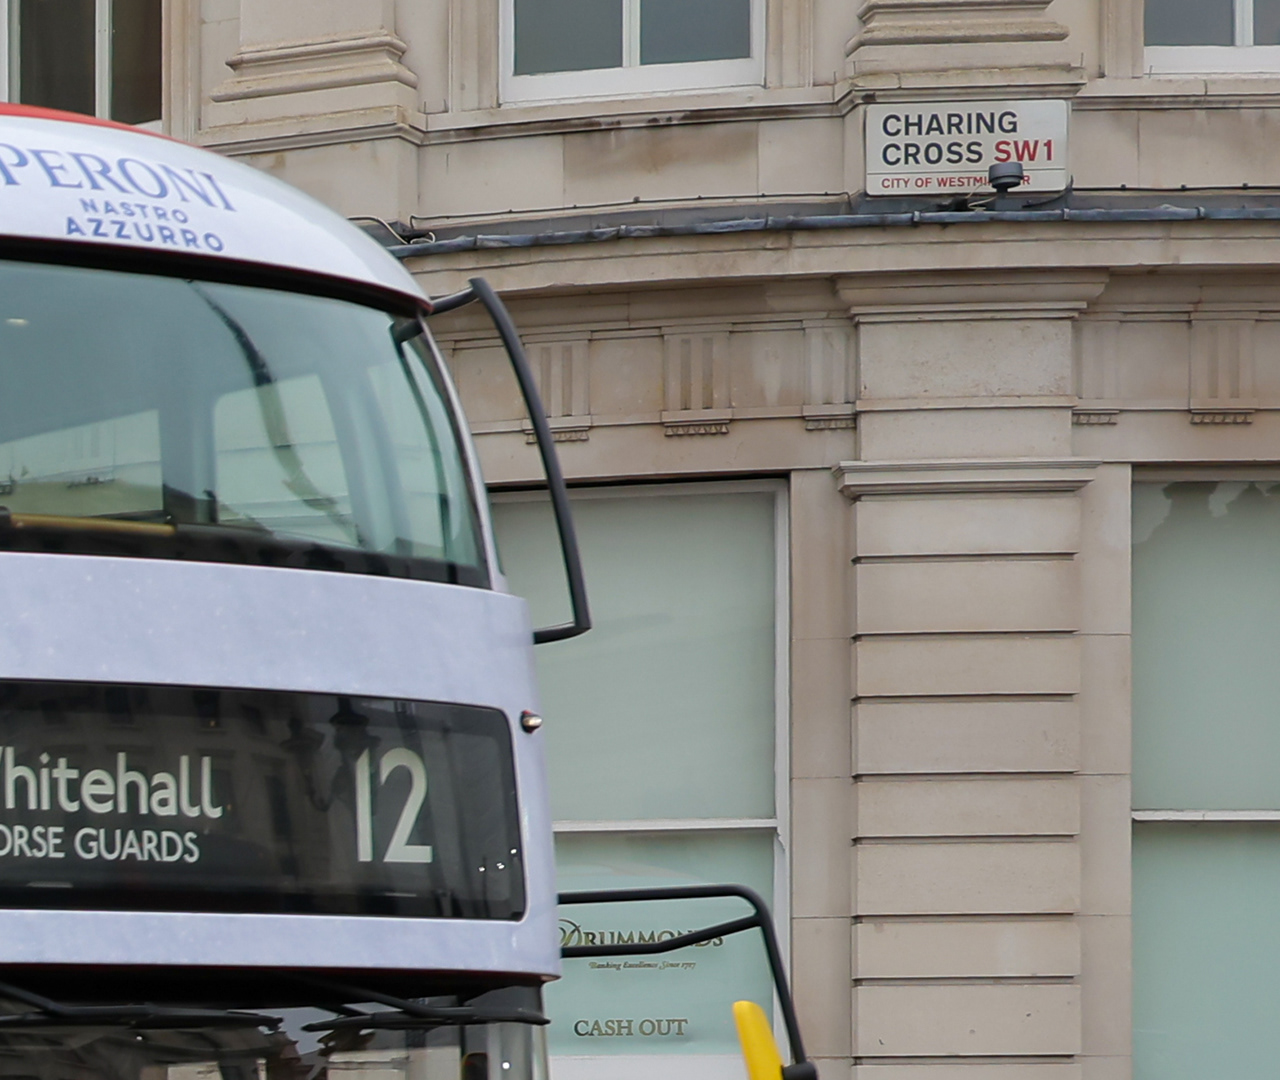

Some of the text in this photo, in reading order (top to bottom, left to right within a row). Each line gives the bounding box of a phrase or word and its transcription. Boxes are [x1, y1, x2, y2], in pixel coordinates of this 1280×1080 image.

[882, 111, 1018, 137] CHARING
[882, 139, 1053, 165] CROSS SW1
[881, 174, 1031, 189] CITY OF WESTMIR
[79, 198, 189, 225] NASTRO
[66, 217, 224, 252] AZZURRO
[356, 747, 433, 863] 12
[75, 826, 200, 863] GUARDS
[574, 1019, 688, 1036] CASH OUT
